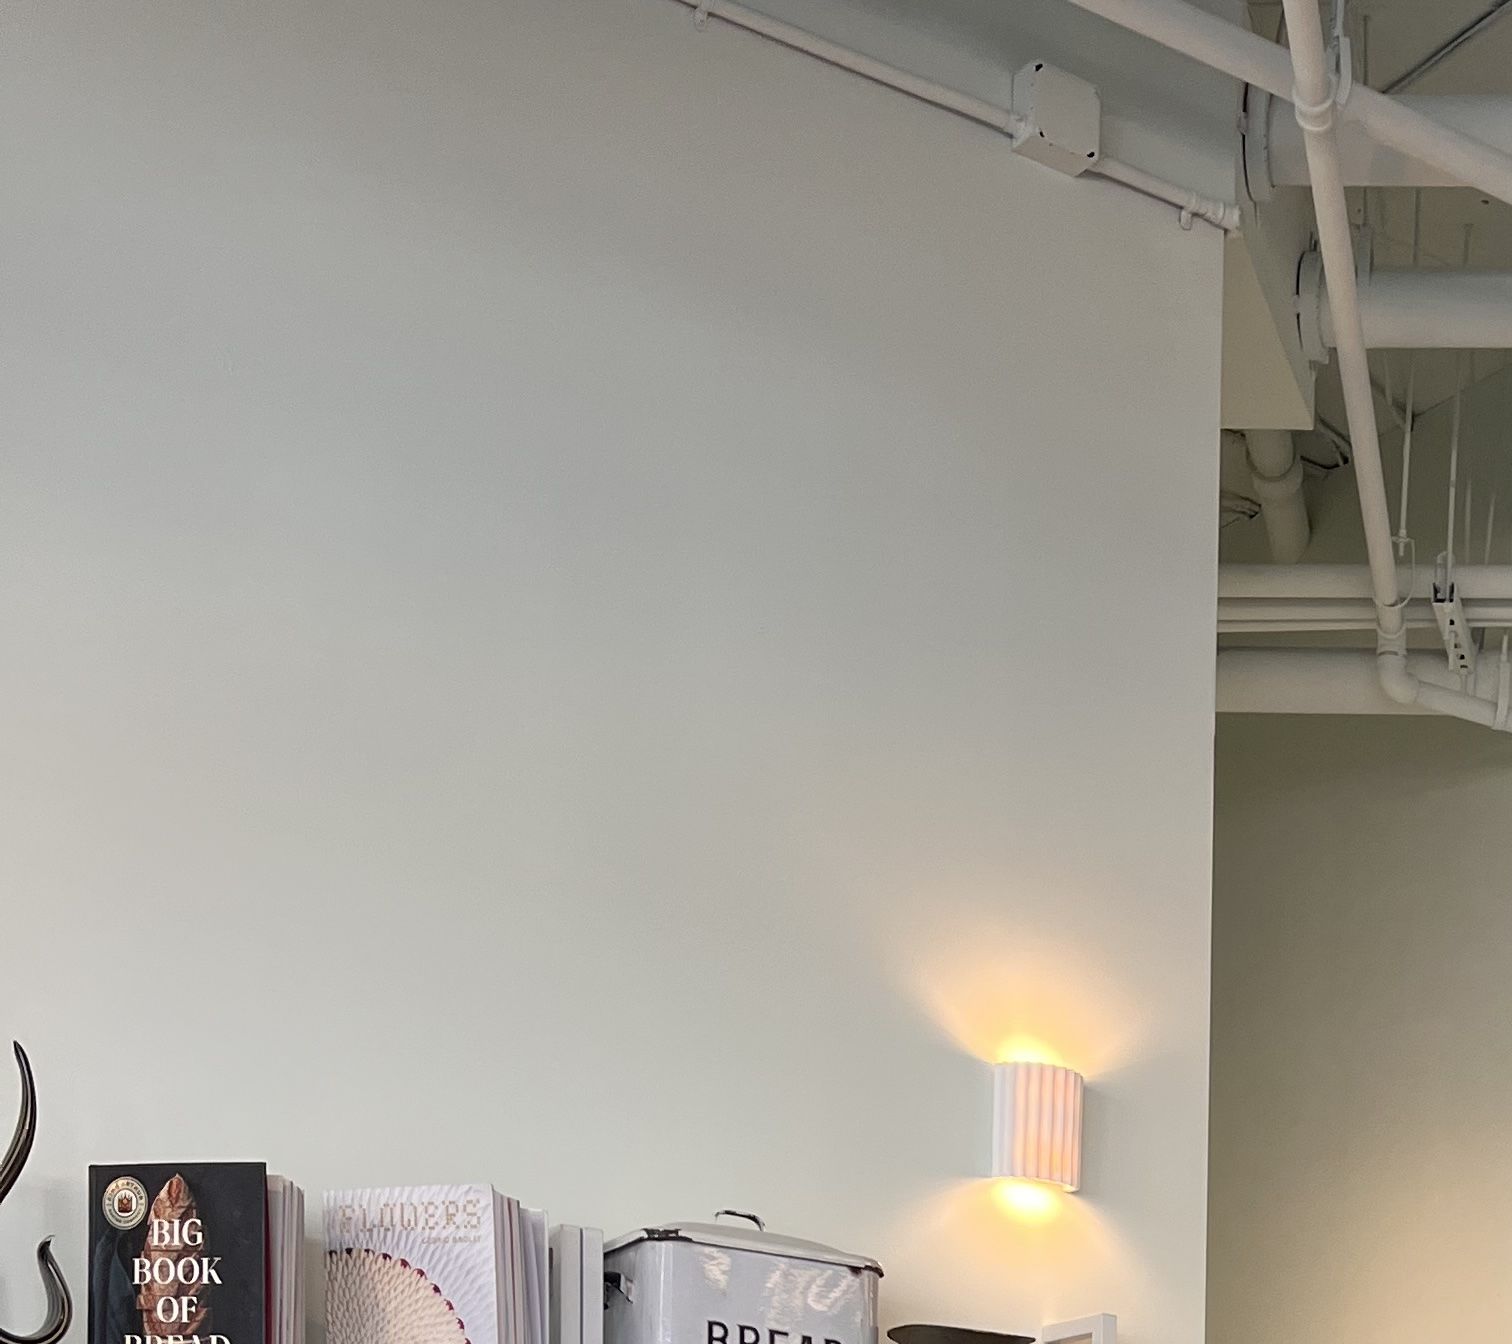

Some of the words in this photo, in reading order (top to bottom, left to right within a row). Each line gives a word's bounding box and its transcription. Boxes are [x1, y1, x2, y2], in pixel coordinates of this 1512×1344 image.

[151, 1218, 203, 1246] BIG
[132, 1256, 222, 1285] BOOK
[156, 1296, 198, 1323] OF
